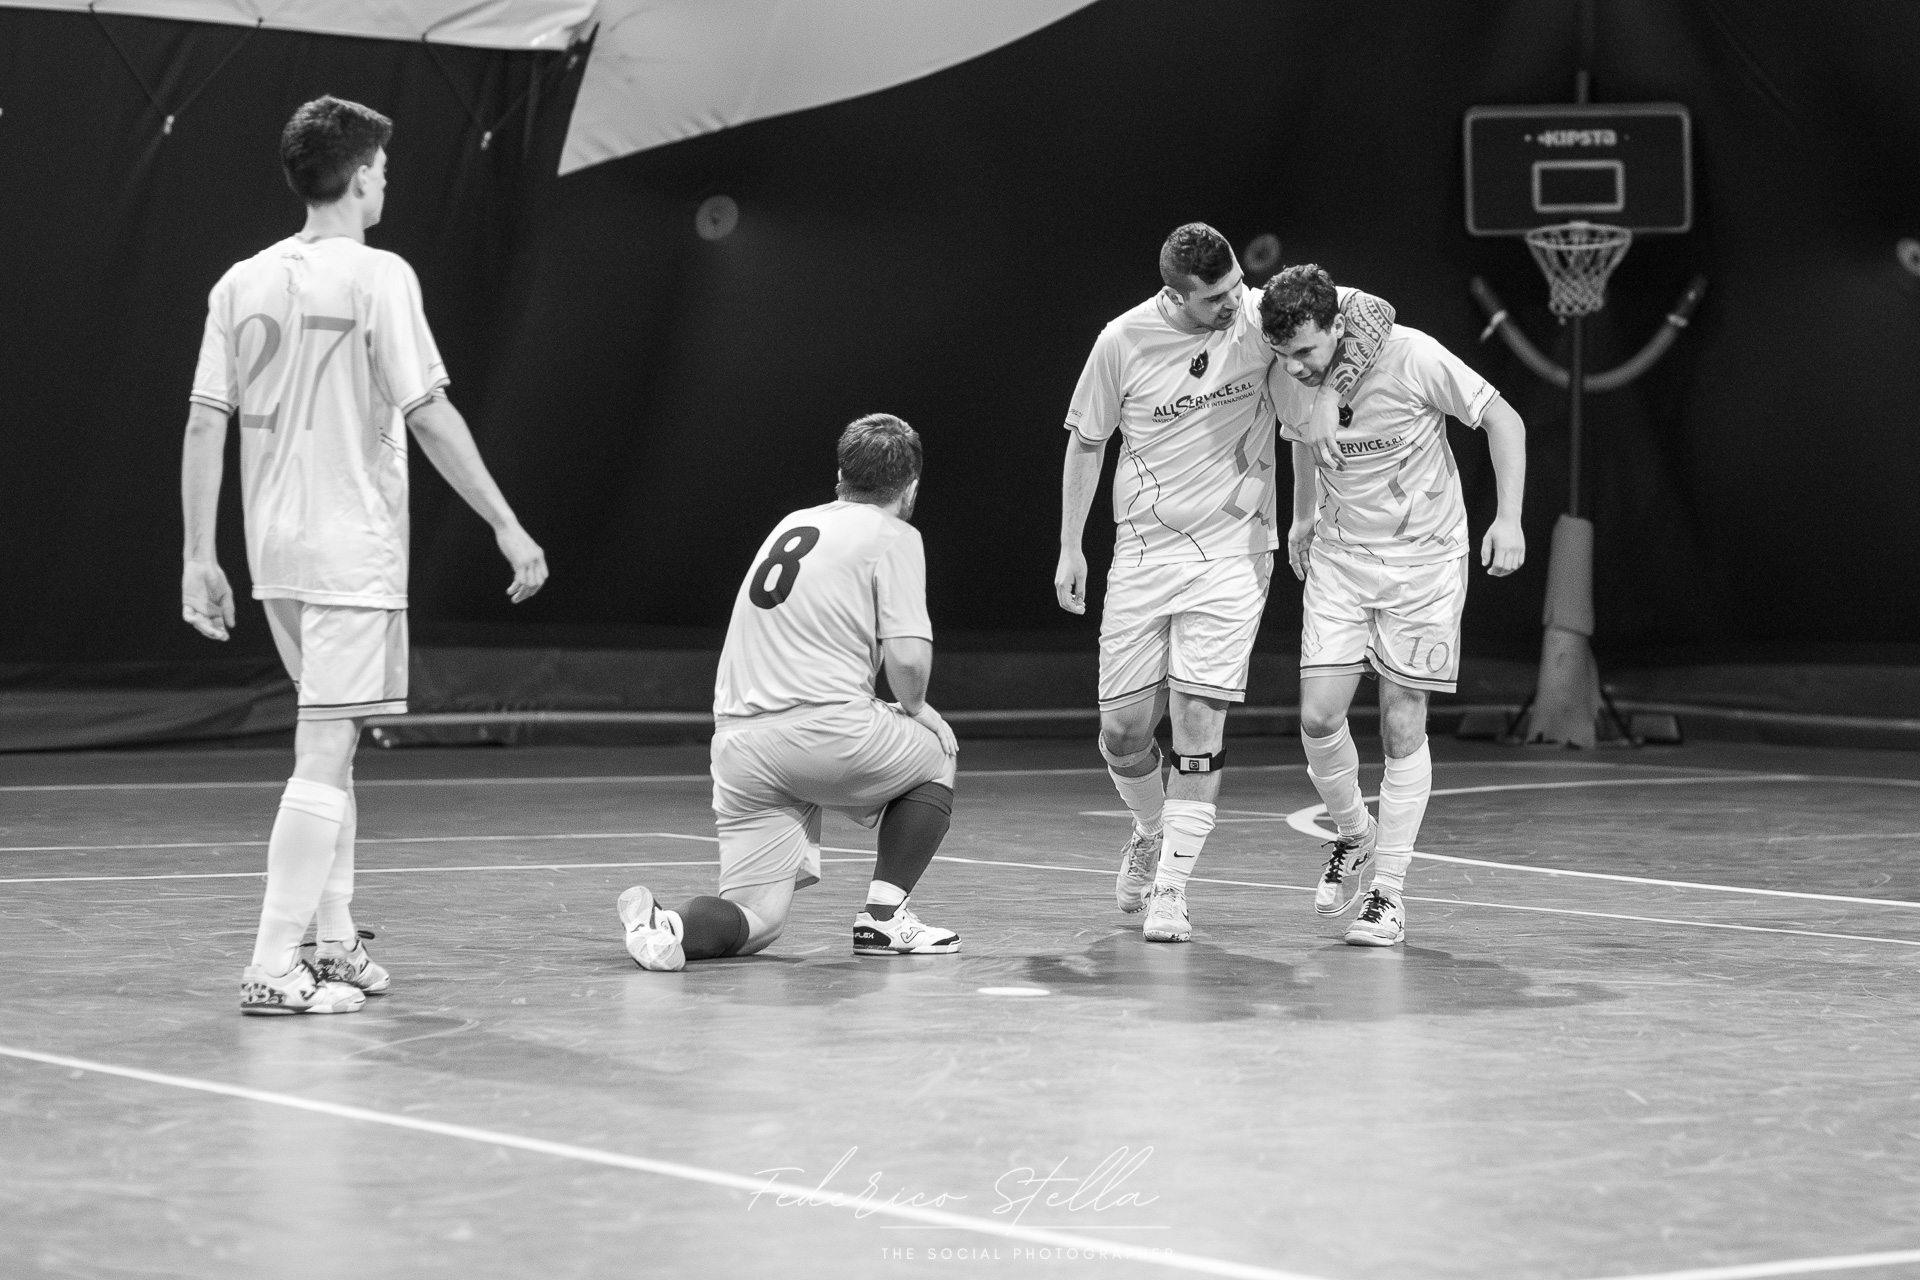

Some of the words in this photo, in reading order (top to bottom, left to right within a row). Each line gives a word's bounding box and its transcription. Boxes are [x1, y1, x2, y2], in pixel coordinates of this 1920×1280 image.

[234, 313, 356, 433] 27
[749, 526, 820, 610] 8
[1403, 636, 1449, 673] 10
